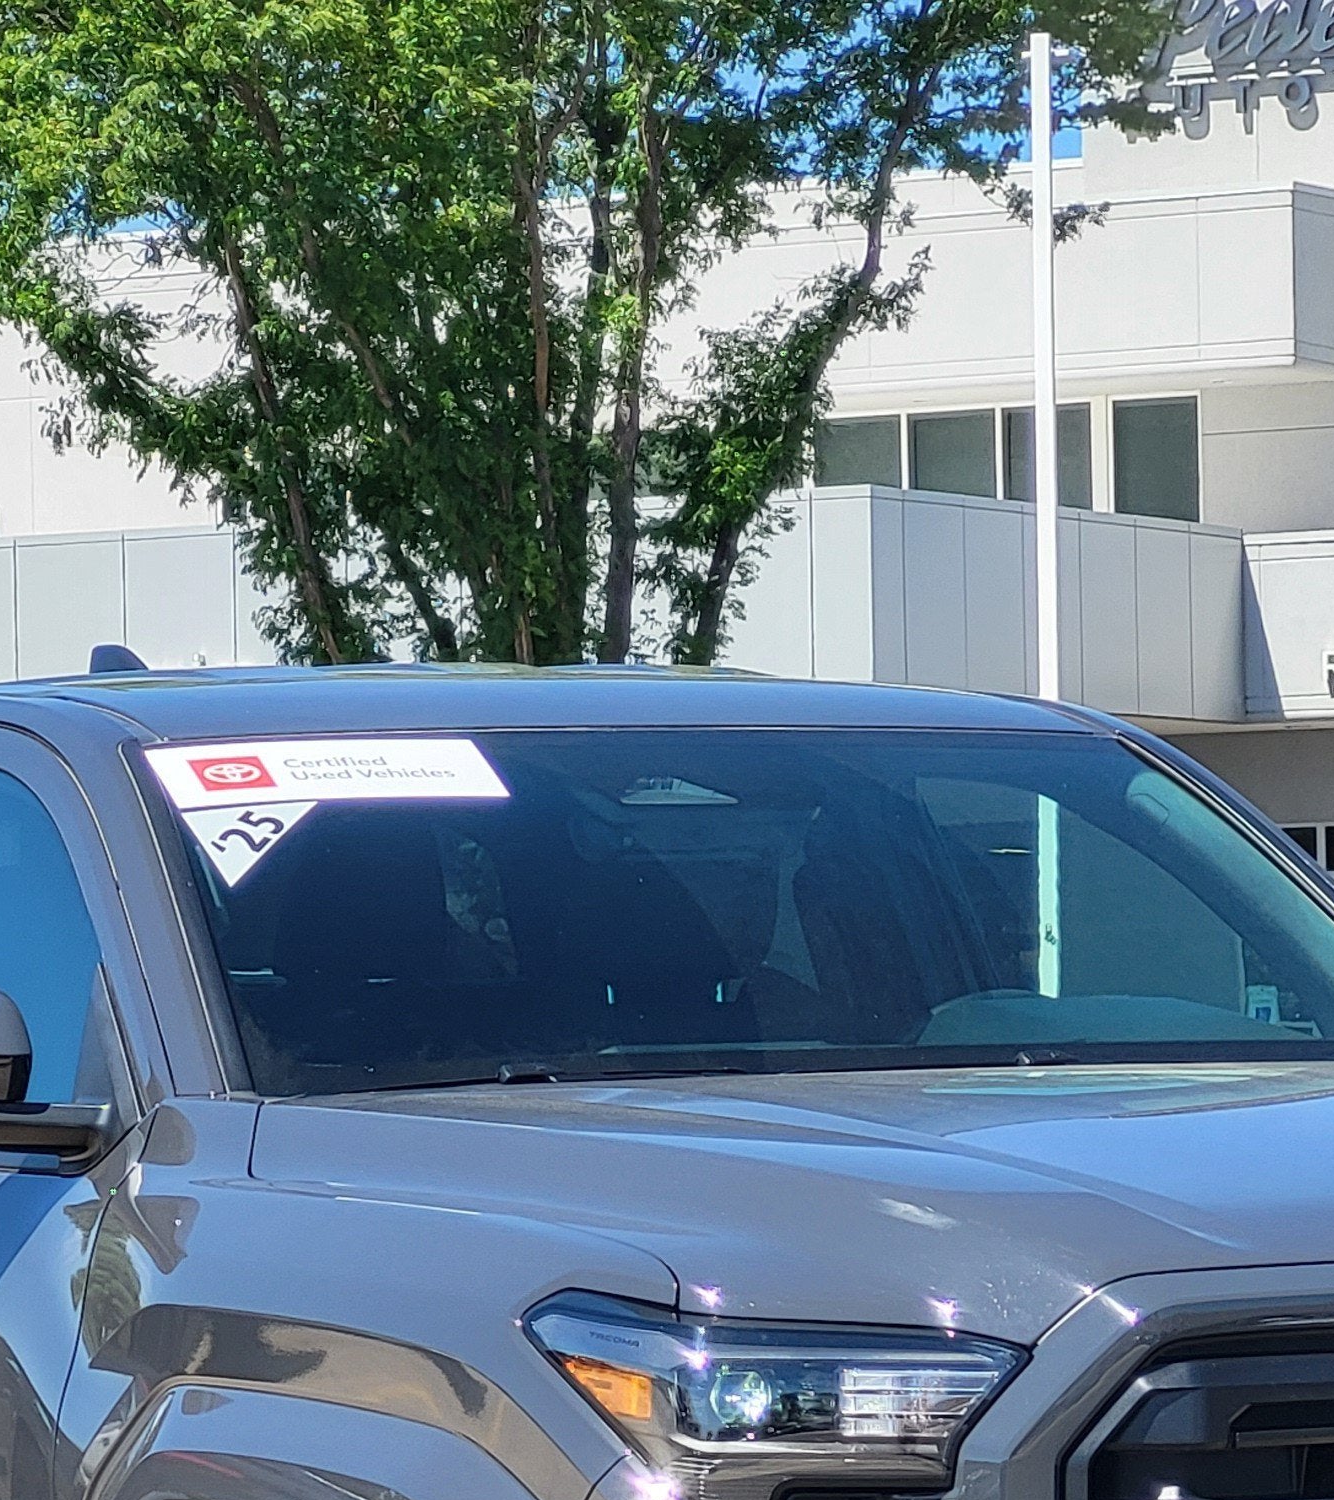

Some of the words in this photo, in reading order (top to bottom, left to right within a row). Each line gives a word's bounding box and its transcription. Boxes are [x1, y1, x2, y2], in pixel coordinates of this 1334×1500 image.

[1117, 72, 1313, 118] UTO
[283, 756, 388, 769] Certified
[290, 769, 353, 781] Used
[356, 767, 456, 779] Vehicles
[210, 810, 285, 853] '25
